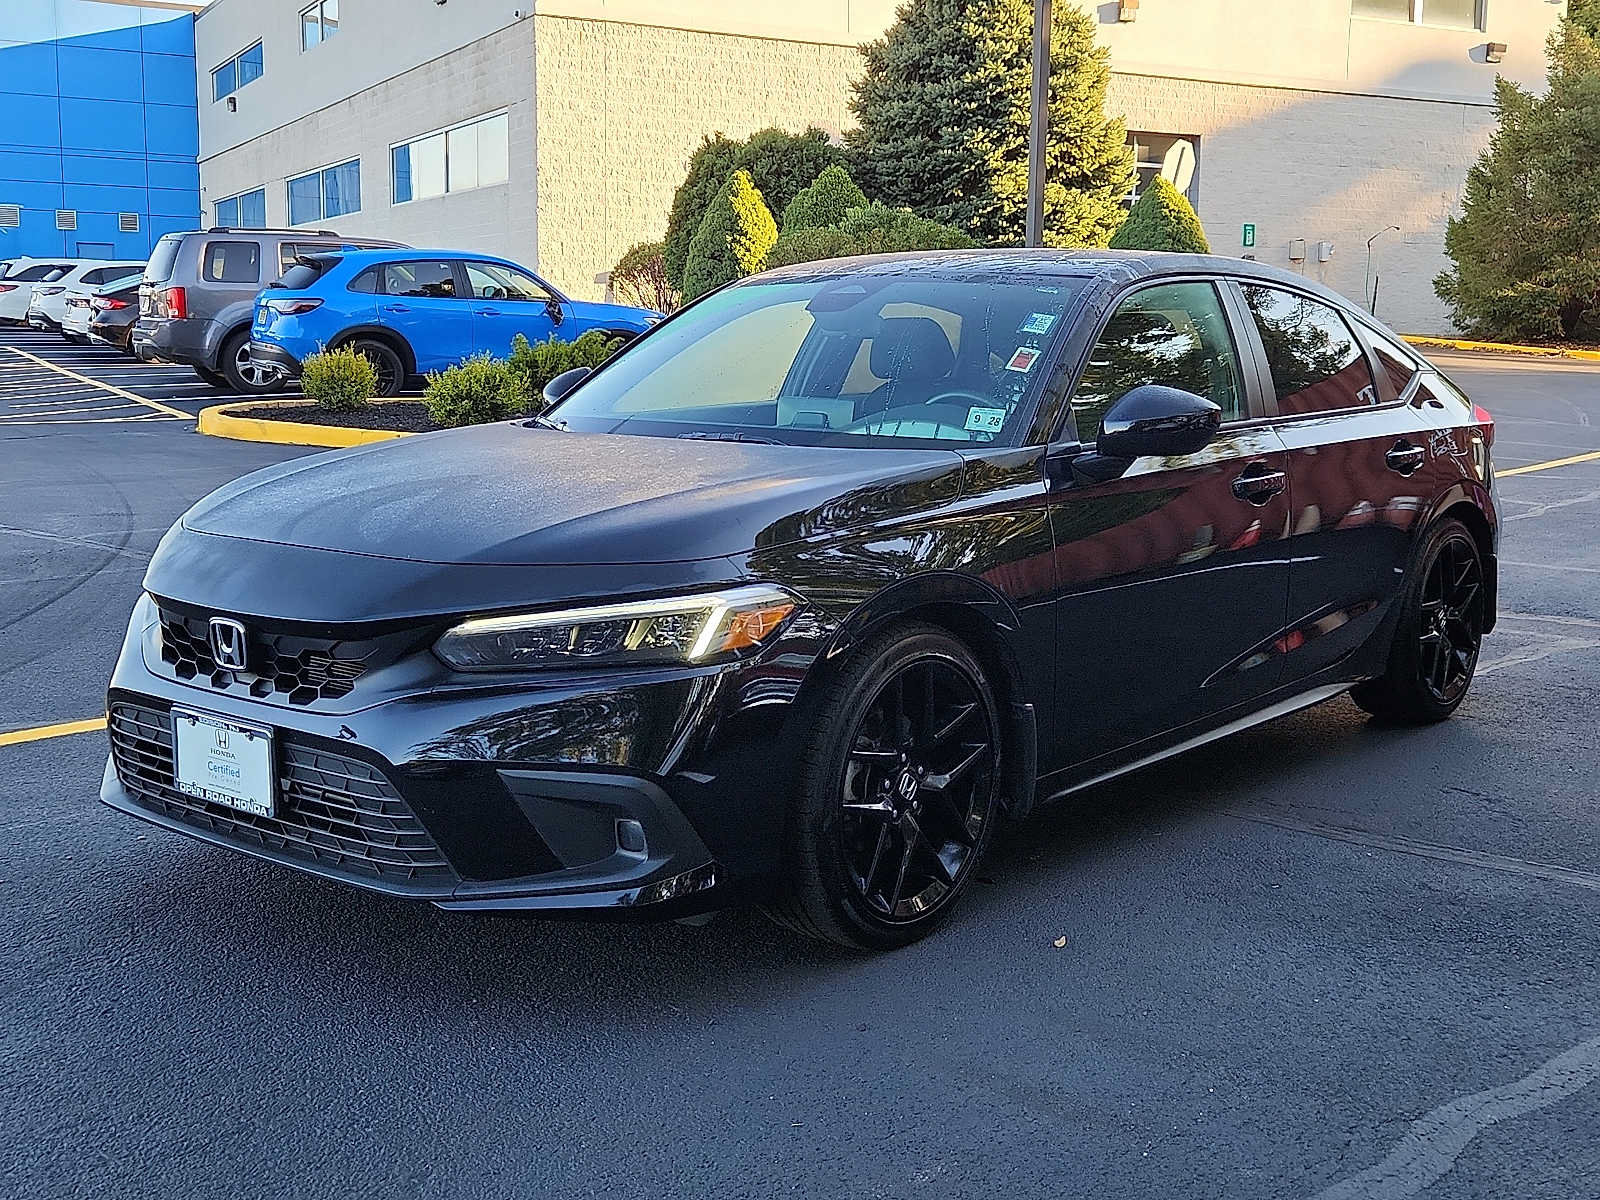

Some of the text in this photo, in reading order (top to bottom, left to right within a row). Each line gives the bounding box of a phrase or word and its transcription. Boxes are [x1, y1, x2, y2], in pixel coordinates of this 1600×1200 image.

[973, 414, 1002, 427] 9 28
[210, 747, 236, 760] HONDA
[207, 760, 241, 778] Certified
[179, 782, 204, 798] OPEN
[205, 789, 232, 805] ROAD
[233, 797, 268, 817] HONDA
